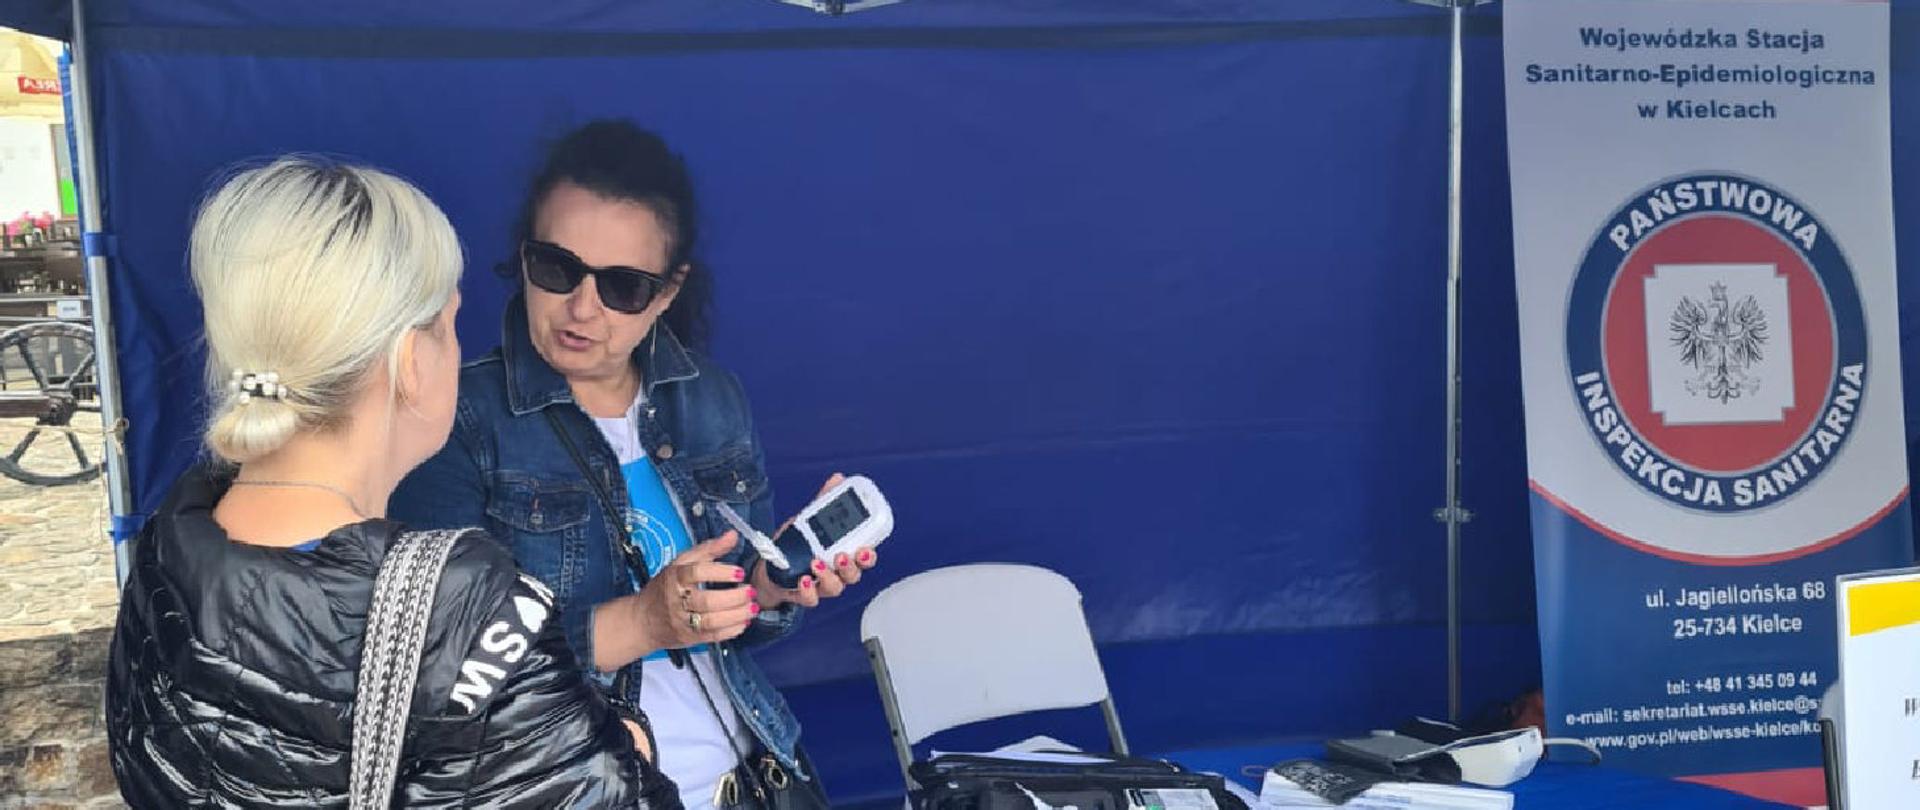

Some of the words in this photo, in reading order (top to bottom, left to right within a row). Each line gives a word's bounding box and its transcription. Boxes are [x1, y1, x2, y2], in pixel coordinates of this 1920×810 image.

[1579, 27, 1738, 51] Wojewódzka
[1747, 29, 1824, 54] Stacja
[1525, 64, 1875, 88] Sanitarno-Epidemiologiczna
[1637, 104, 1658, 119] w
[1667, 100, 1777, 119] Kielcach
[1608, 181, 1819, 251] PAŃSTWOWA
[1576, 371, 1724, 506] INSPEKCJA
[1733, 362, 1864, 506] SANITARNA
[1645, 589, 1670, 608] ul.
[1675, 583, 1797, 610] Jagiellońska
[1802, 581, 1826, 600] 68
[1673, 617, 1736, 639] 25-734
[1742, 614, 1803, 634] Kielce
[1666, 680, 1691, 695] tel:
[1695, 677, 1722, 693] +48
[1725, 676, 1742, 691] 41
[1747, 674, 1774, 689] 345
[1777, 672, 1796, 688] 09
[1799, 671, 1817, 686] 44
[1565, 707, 1618, 725] e-mail:
[1623, 695, 1821, 722] sekretariat.wsse.kielce@s
